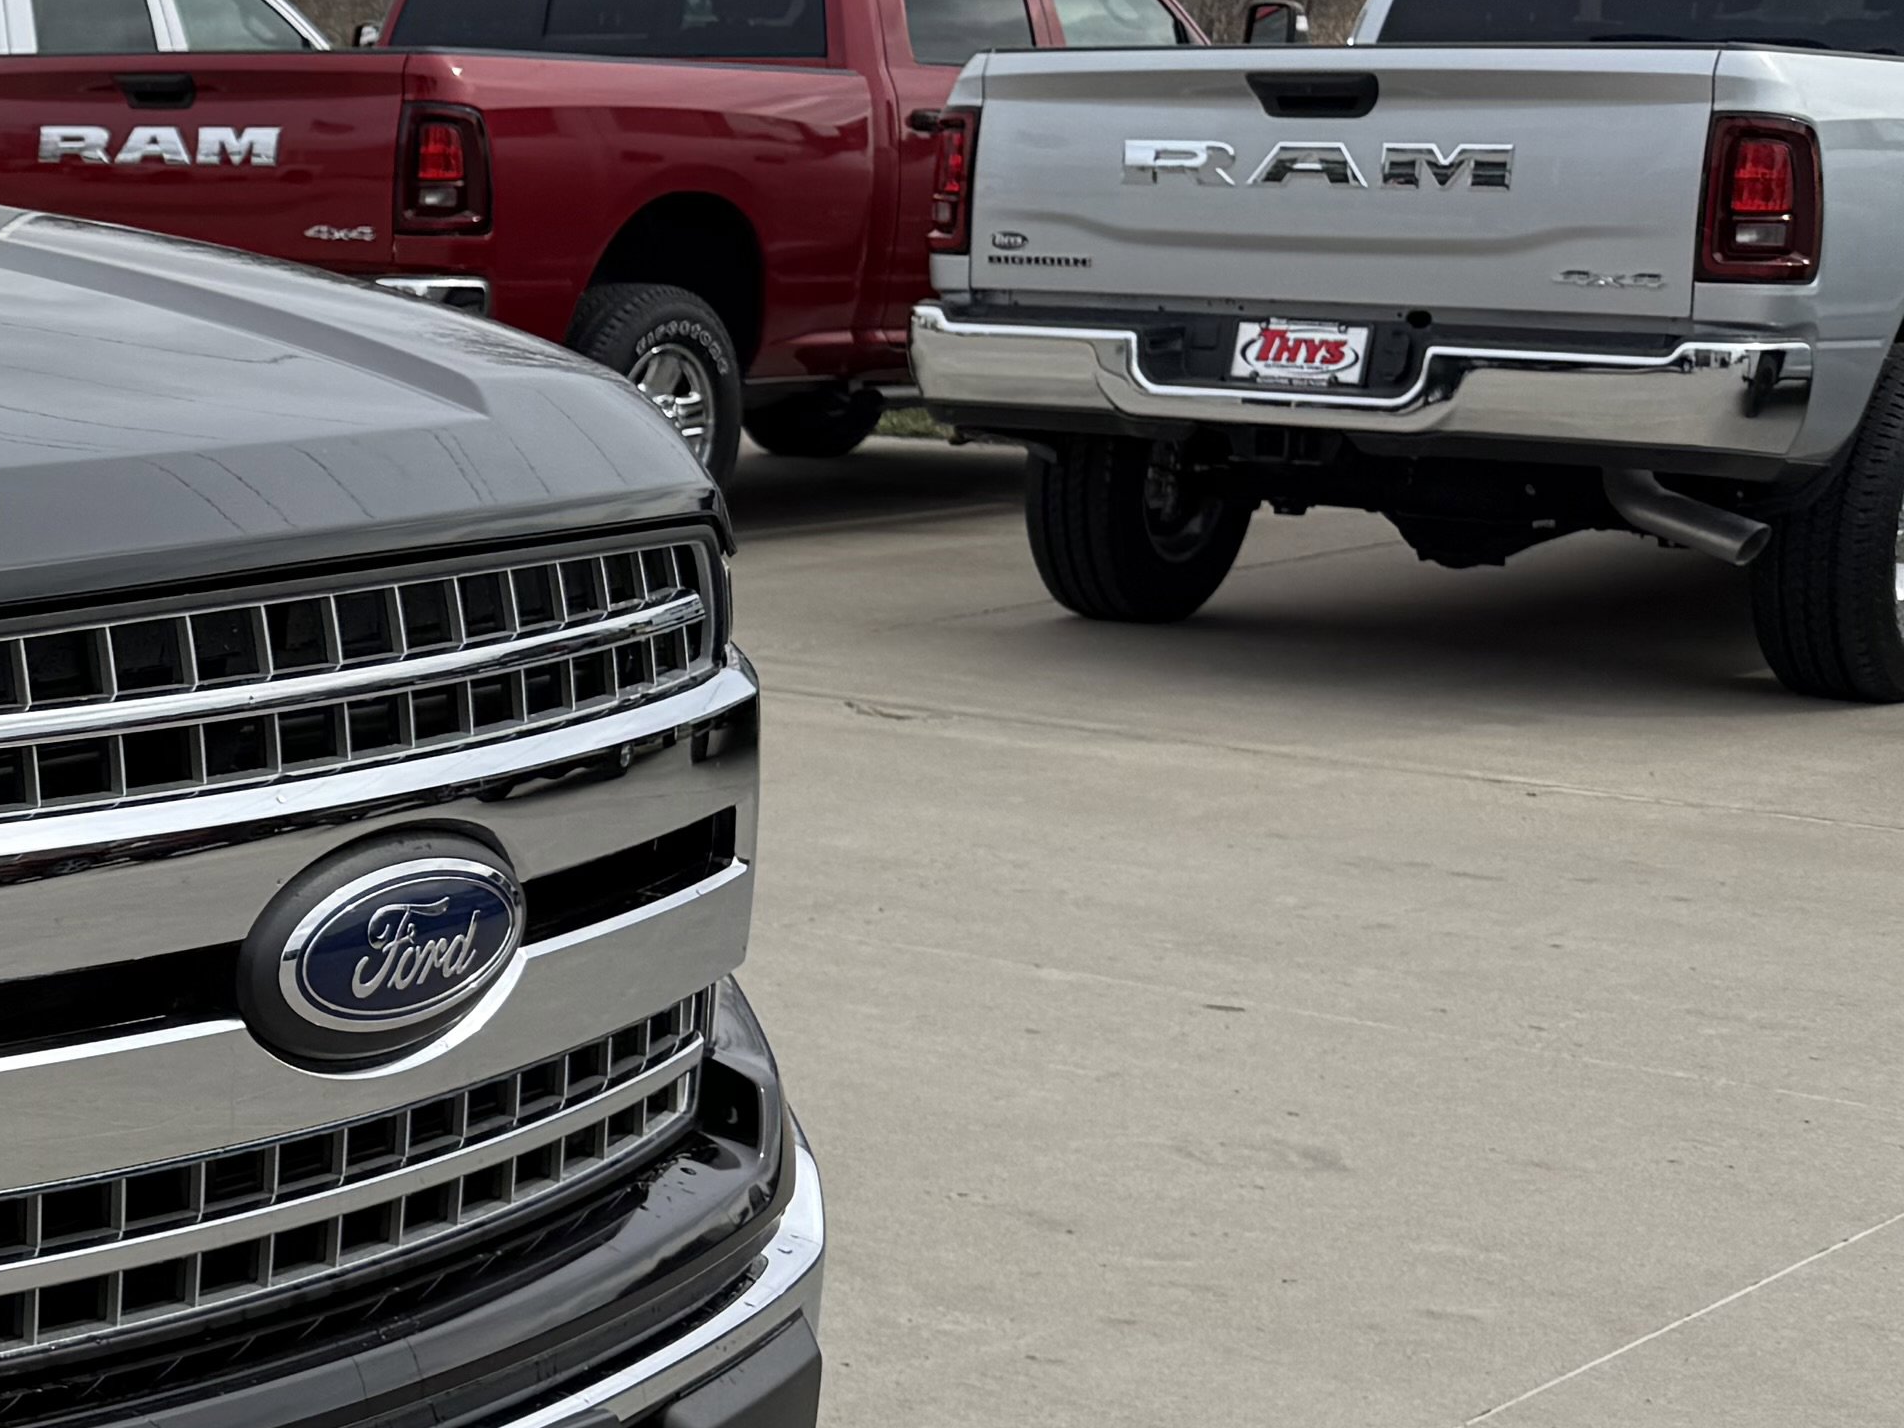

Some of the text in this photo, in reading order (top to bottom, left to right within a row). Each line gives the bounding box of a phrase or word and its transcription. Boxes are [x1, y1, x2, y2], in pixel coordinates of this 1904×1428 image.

[38, 125, 283, 167] RAM
[1121, 139, 1514, 190] RAM
[1254, 328, 1348, 365] THYS
[351, 896, 481, 998] Ford
